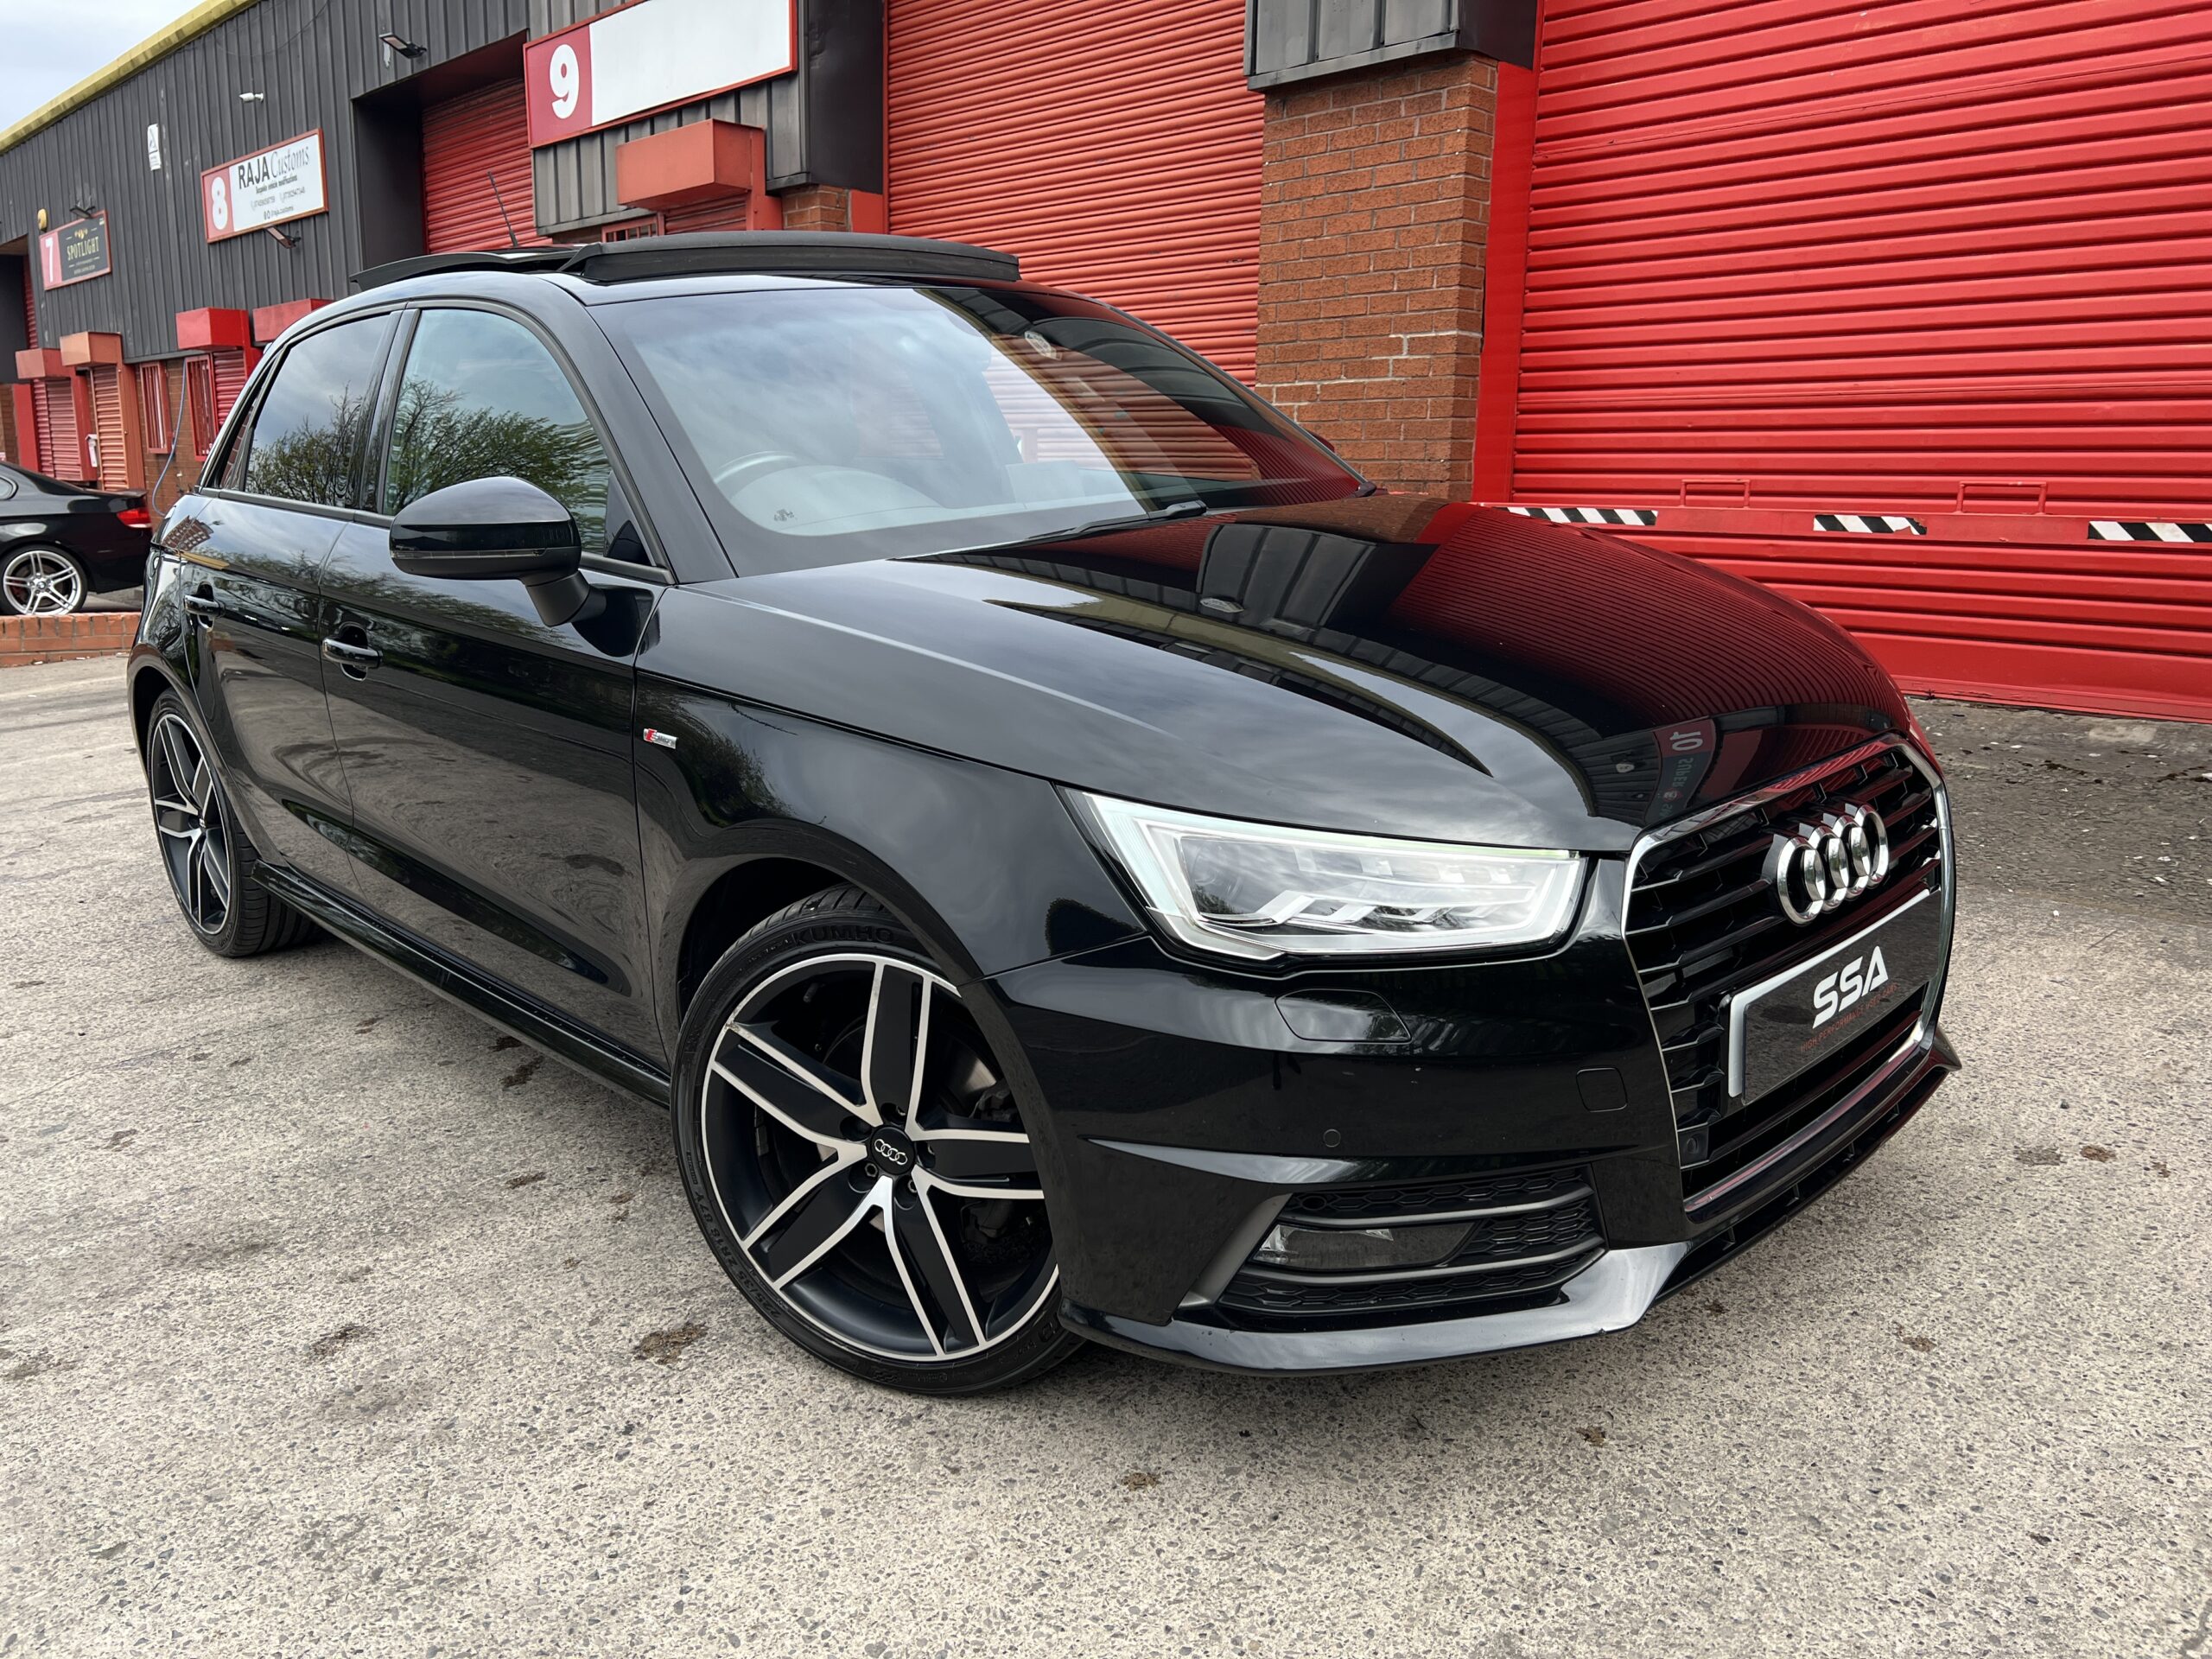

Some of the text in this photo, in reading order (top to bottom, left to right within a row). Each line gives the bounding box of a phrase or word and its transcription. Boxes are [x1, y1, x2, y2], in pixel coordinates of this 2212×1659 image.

[549, 43, 580, 119] 9
[238, 146, 309, 189] RAJA Customs
[211, 176, 228, 231] 8
[45, 237, 54, 283] 7
[67, 236, 99, 261] SPOTLIGHT
[791, 924, 894, 947] KUMHO
[1812, 945, 1889, 1029] SSA
